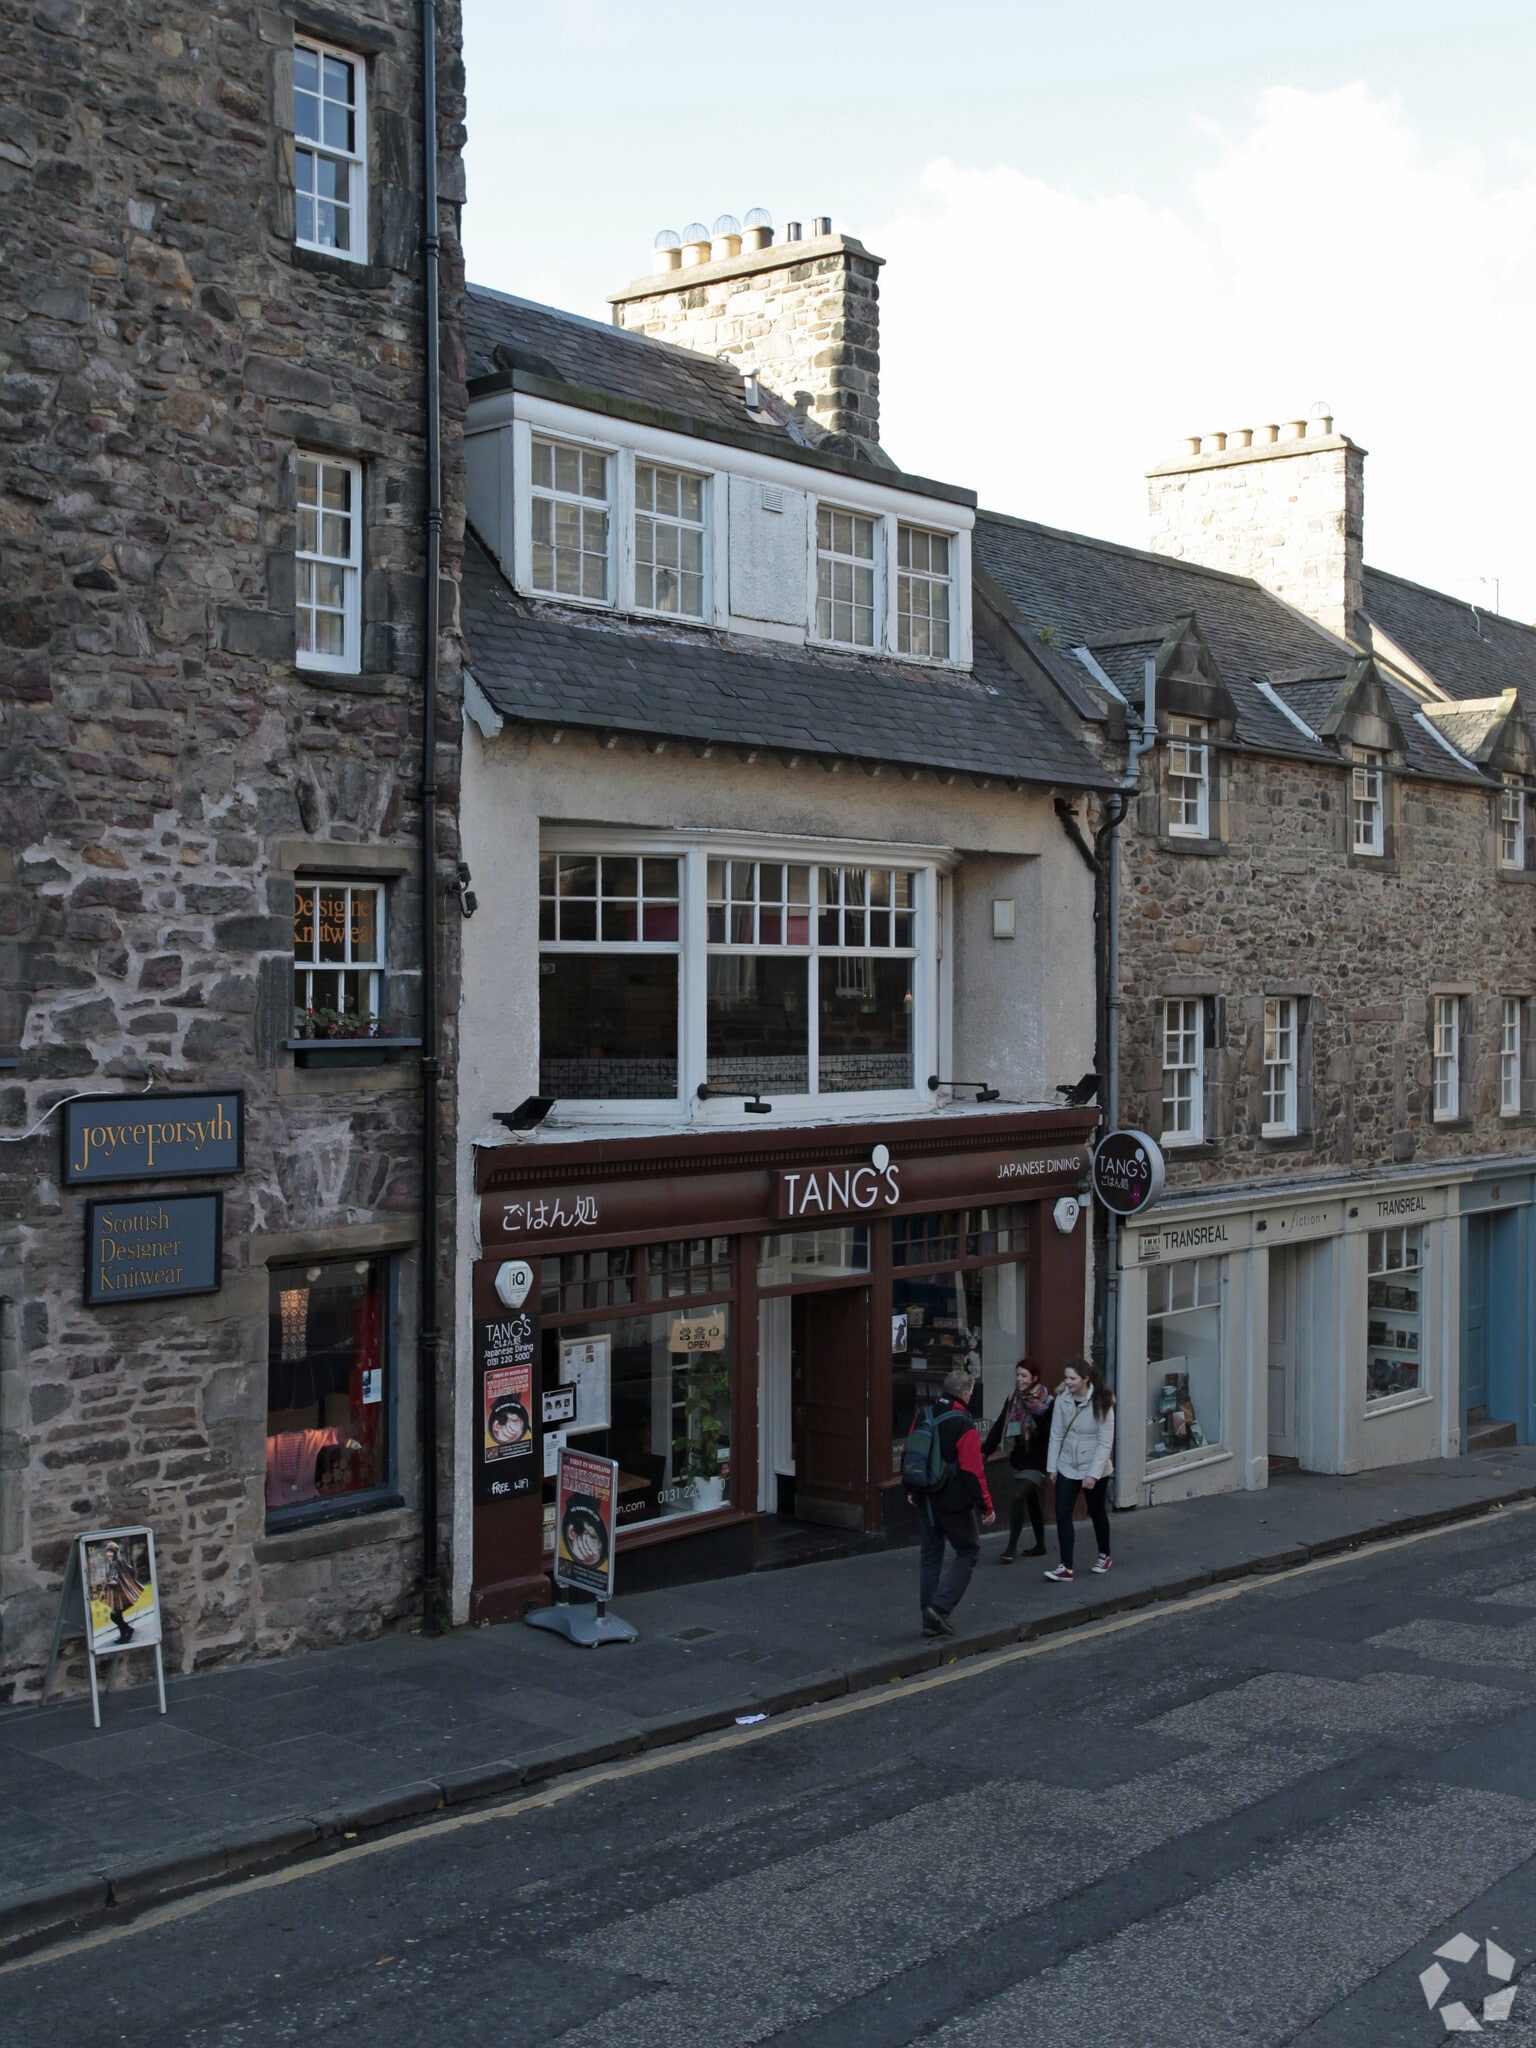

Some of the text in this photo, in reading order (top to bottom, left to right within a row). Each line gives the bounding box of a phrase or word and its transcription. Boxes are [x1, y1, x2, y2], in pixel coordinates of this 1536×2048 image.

[997, 1156, 1081, 1178] JAPANESE DINING
[1099, 1148, 1148, 1179] TANG'S
[783, 1144, 900, 1216] TANG'S
[502, 1195, 599, 1231] ごはん処
[1376, 1196, 1427, 1217] TRANSREAL
[102, 1206, 170, 1235] Scottish
[1162, 1224, 1228, 1250] TRANSREAL
[100, 1238, 181, 1264] Designer
[100, 1266, 183, 1291] Knitwear
[512, 1271, 526, 1286] iQ
[485, 1313, 532, 1341] TANG'S
[679, 1325, 720, 1341] 営業中
[484, 1343, 534, 1358] Japanese Dining
[687, 1340, 711, 1350] OPEN
[486, 1351, 530, 1367] 0131 220 5000
[657, 1487, 680, 1504] 0131
